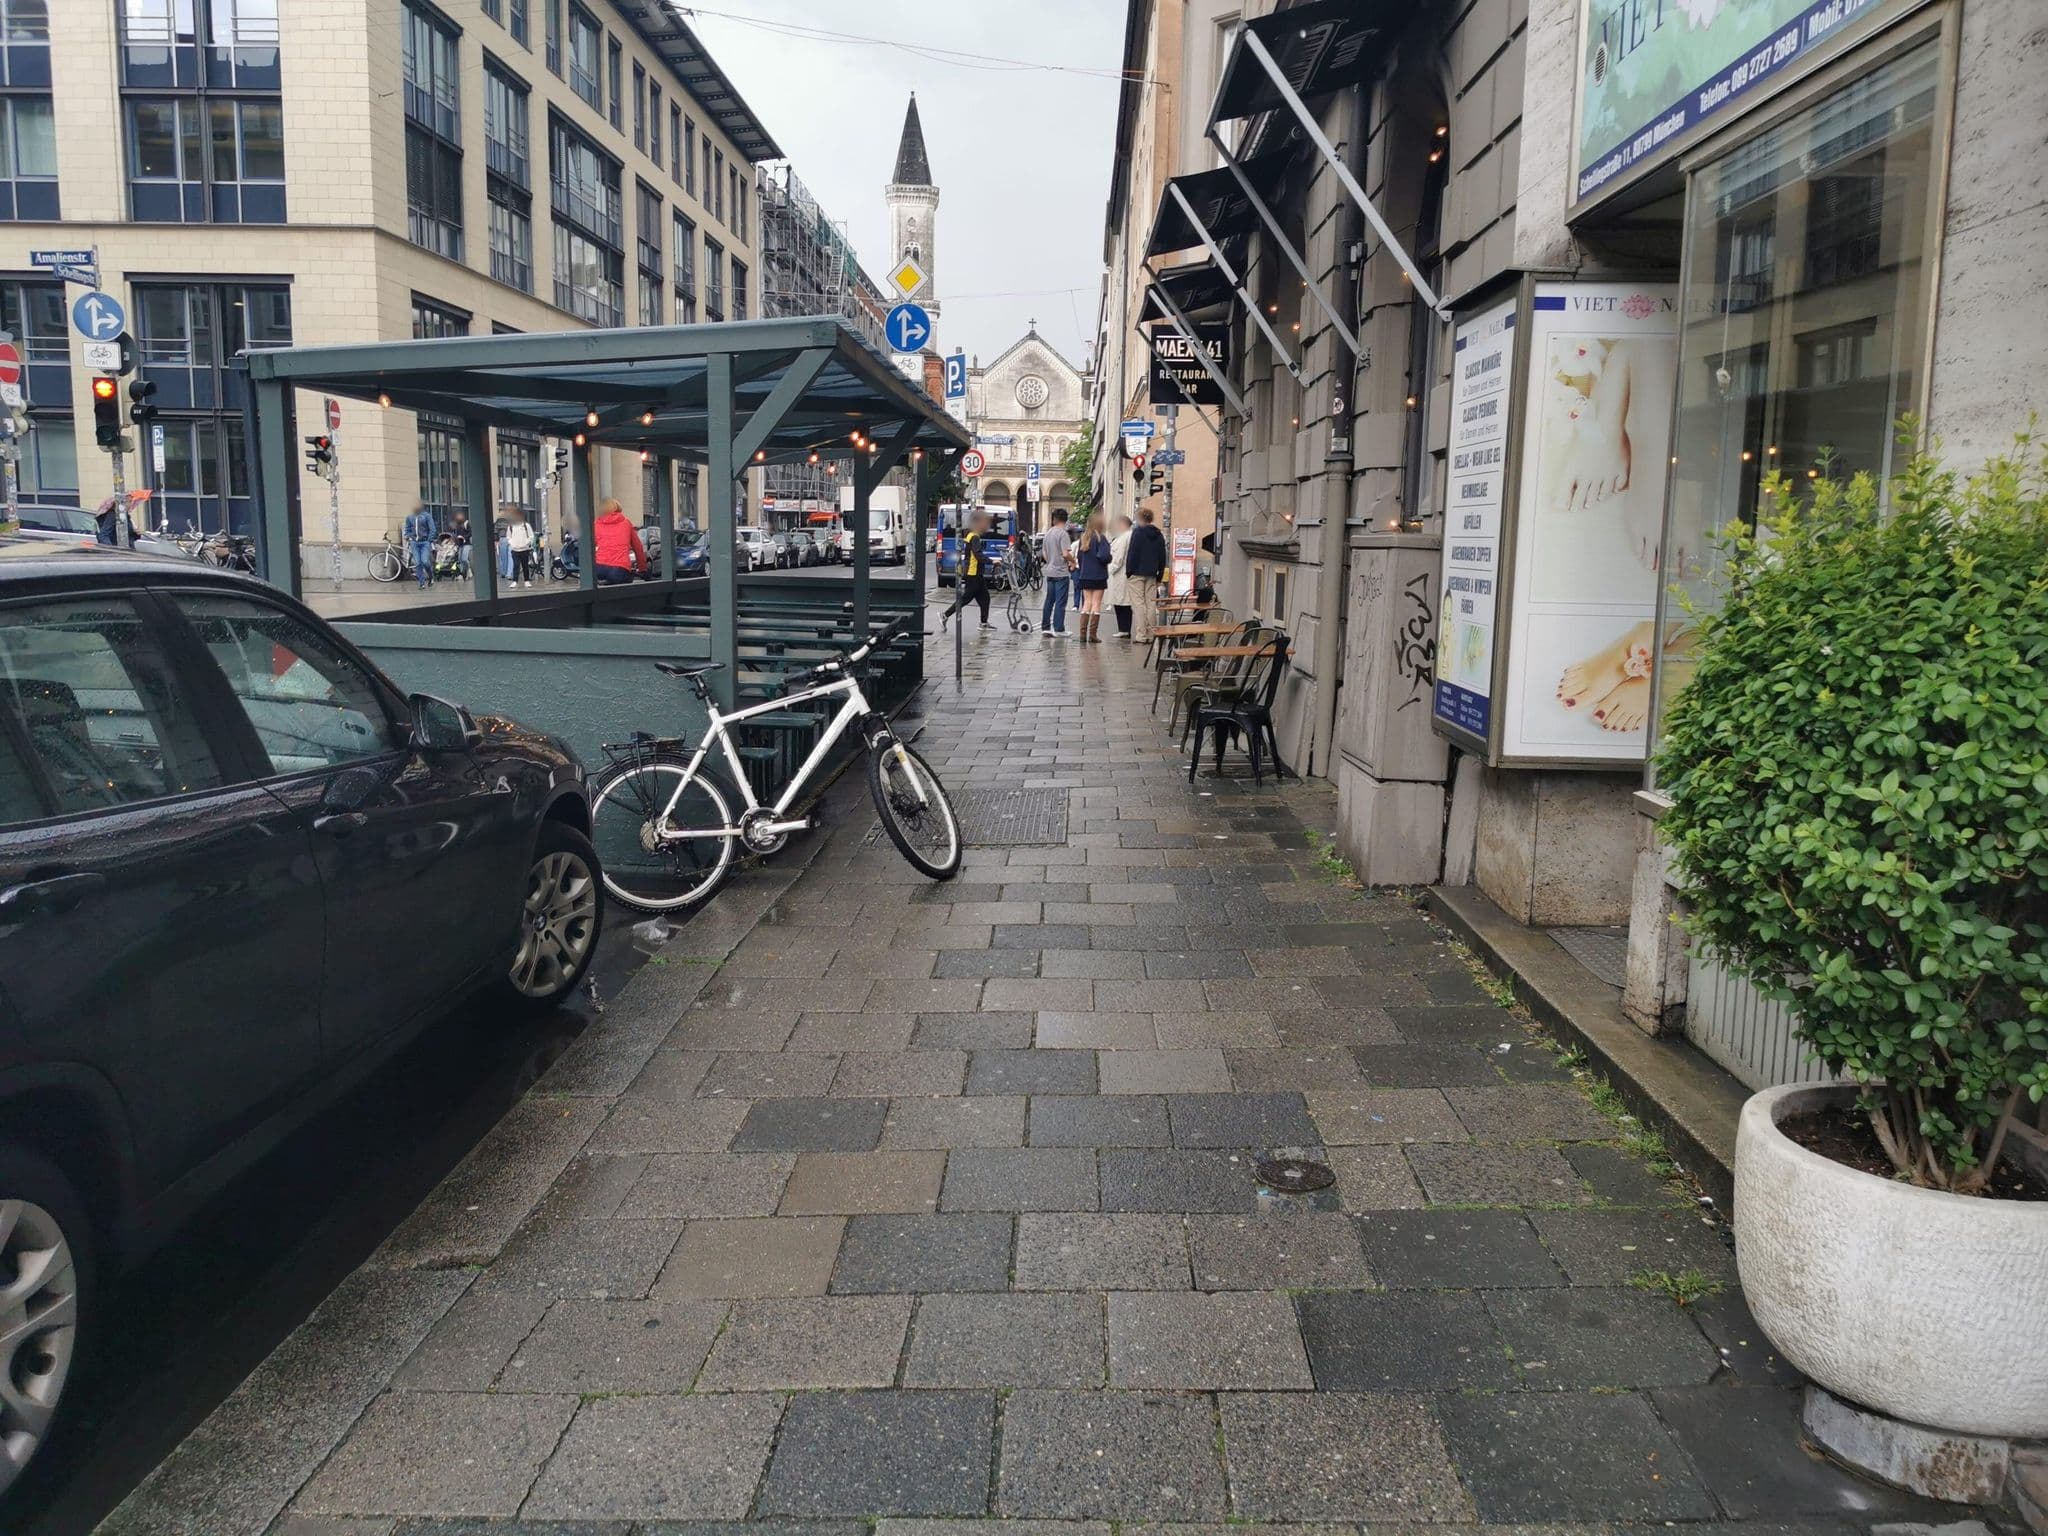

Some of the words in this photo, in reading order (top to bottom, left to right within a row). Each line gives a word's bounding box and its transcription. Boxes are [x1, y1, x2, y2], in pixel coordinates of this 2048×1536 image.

[1653, 110, 1686, 146] München
[1700, 79, 1730, 114] Telefon:
[1731, 62, 1749, 92] 089
[1749, 45, 1773, 80] 2727
[1773, 27, 1799, 65] 2689
[1808, 0, 1843, 41] Mobil:
[35, 250, 89, 263] Amalienstr.
[1573, 296, 1617, 312] VIET
[1206, 340, 1222, 357] 41
[948, 361, 960, 394] P
[964, 458, 980, 469] 30
